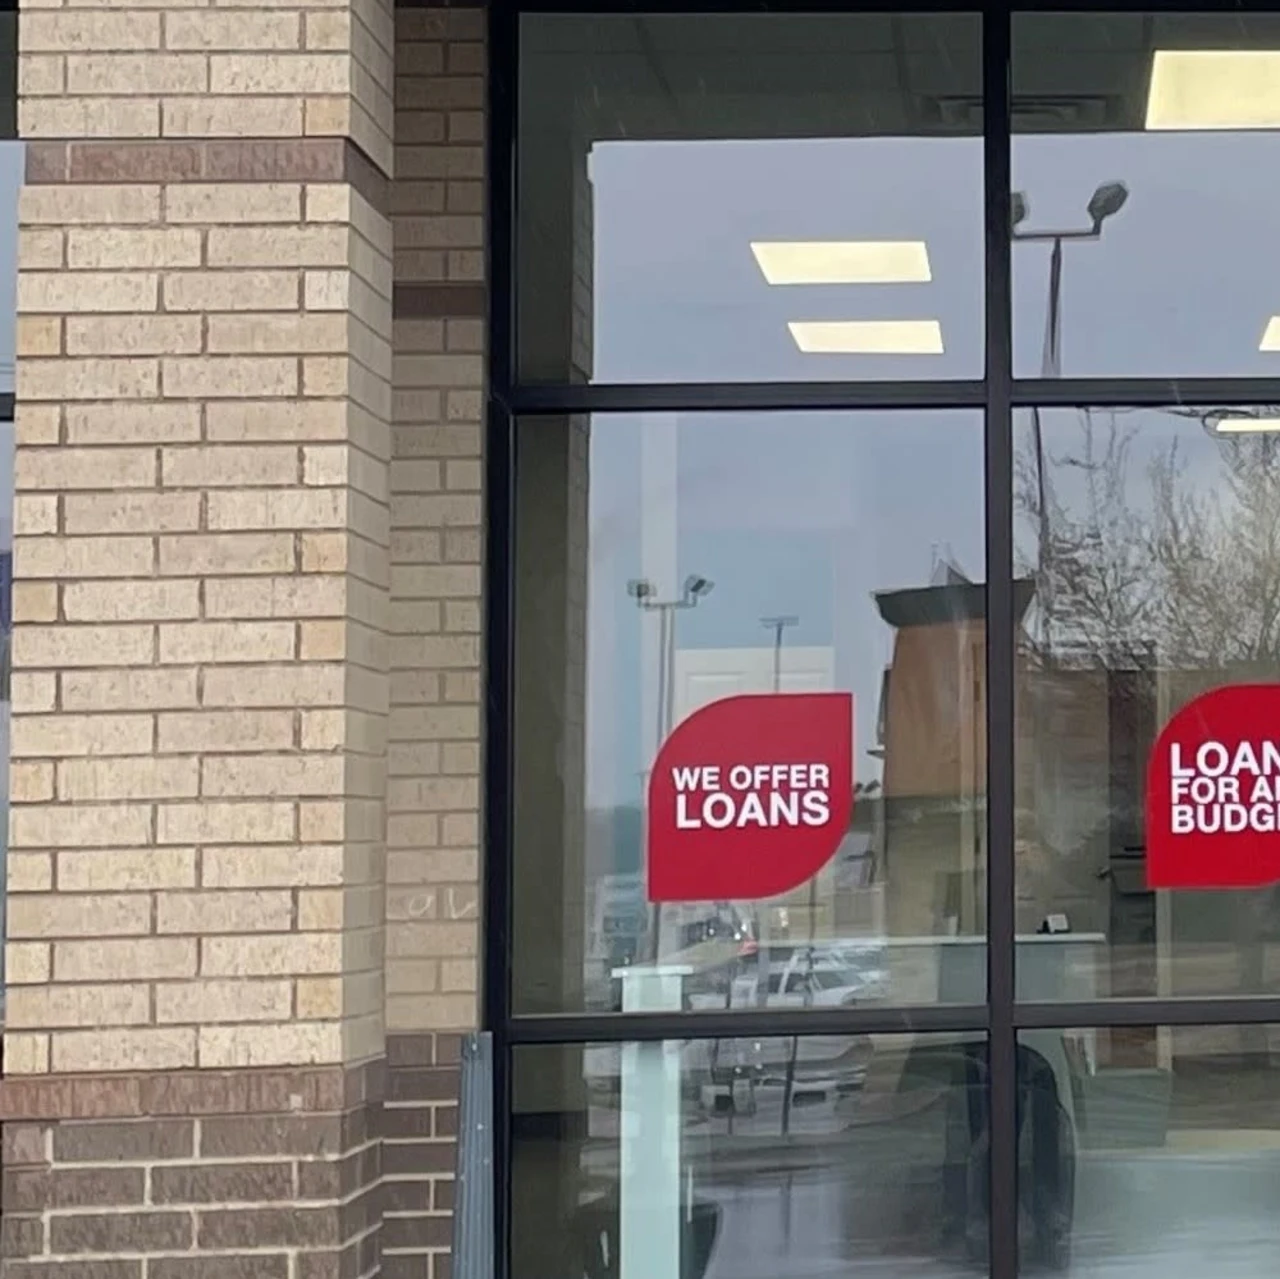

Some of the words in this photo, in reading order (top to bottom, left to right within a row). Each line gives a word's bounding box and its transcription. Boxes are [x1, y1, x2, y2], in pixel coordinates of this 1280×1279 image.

[672, 766, 721, 791] WE
[729, 764, 830, 790] OFFER
[1171, 776, 1240, 805] FOR
[676, 790, 830, 829] LOANS
